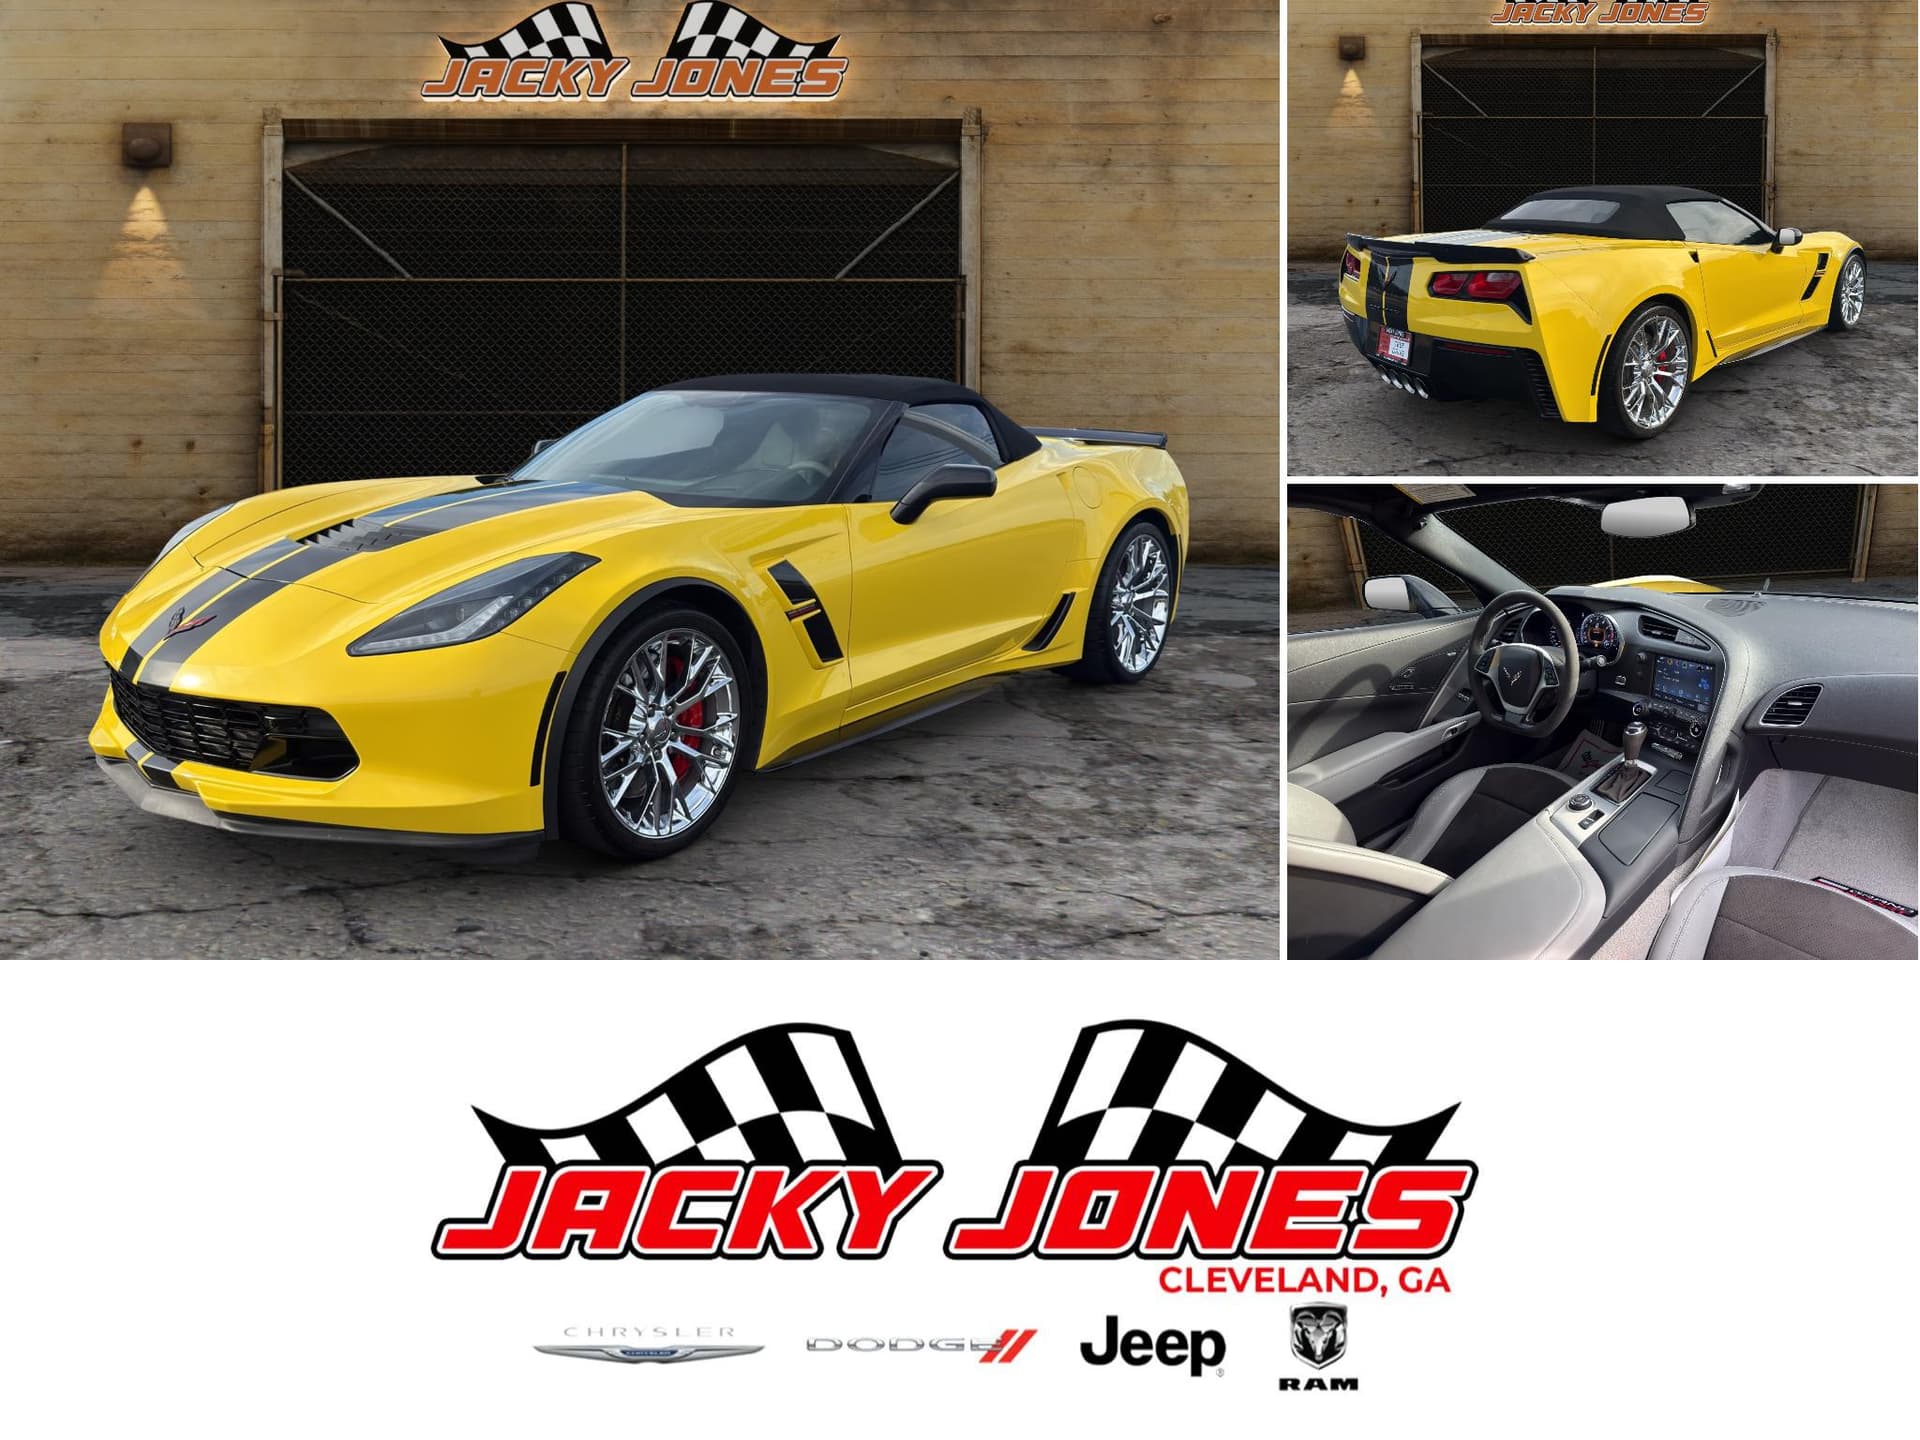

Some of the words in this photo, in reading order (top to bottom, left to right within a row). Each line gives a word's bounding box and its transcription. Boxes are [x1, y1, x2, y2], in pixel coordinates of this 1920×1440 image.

[1491, 2, 1599, 24] JACKY
[1599, 2, 1710, 24] JONES
[420, 57, 630, 98] JACKY
[631, 57, 849, 98] JONES
